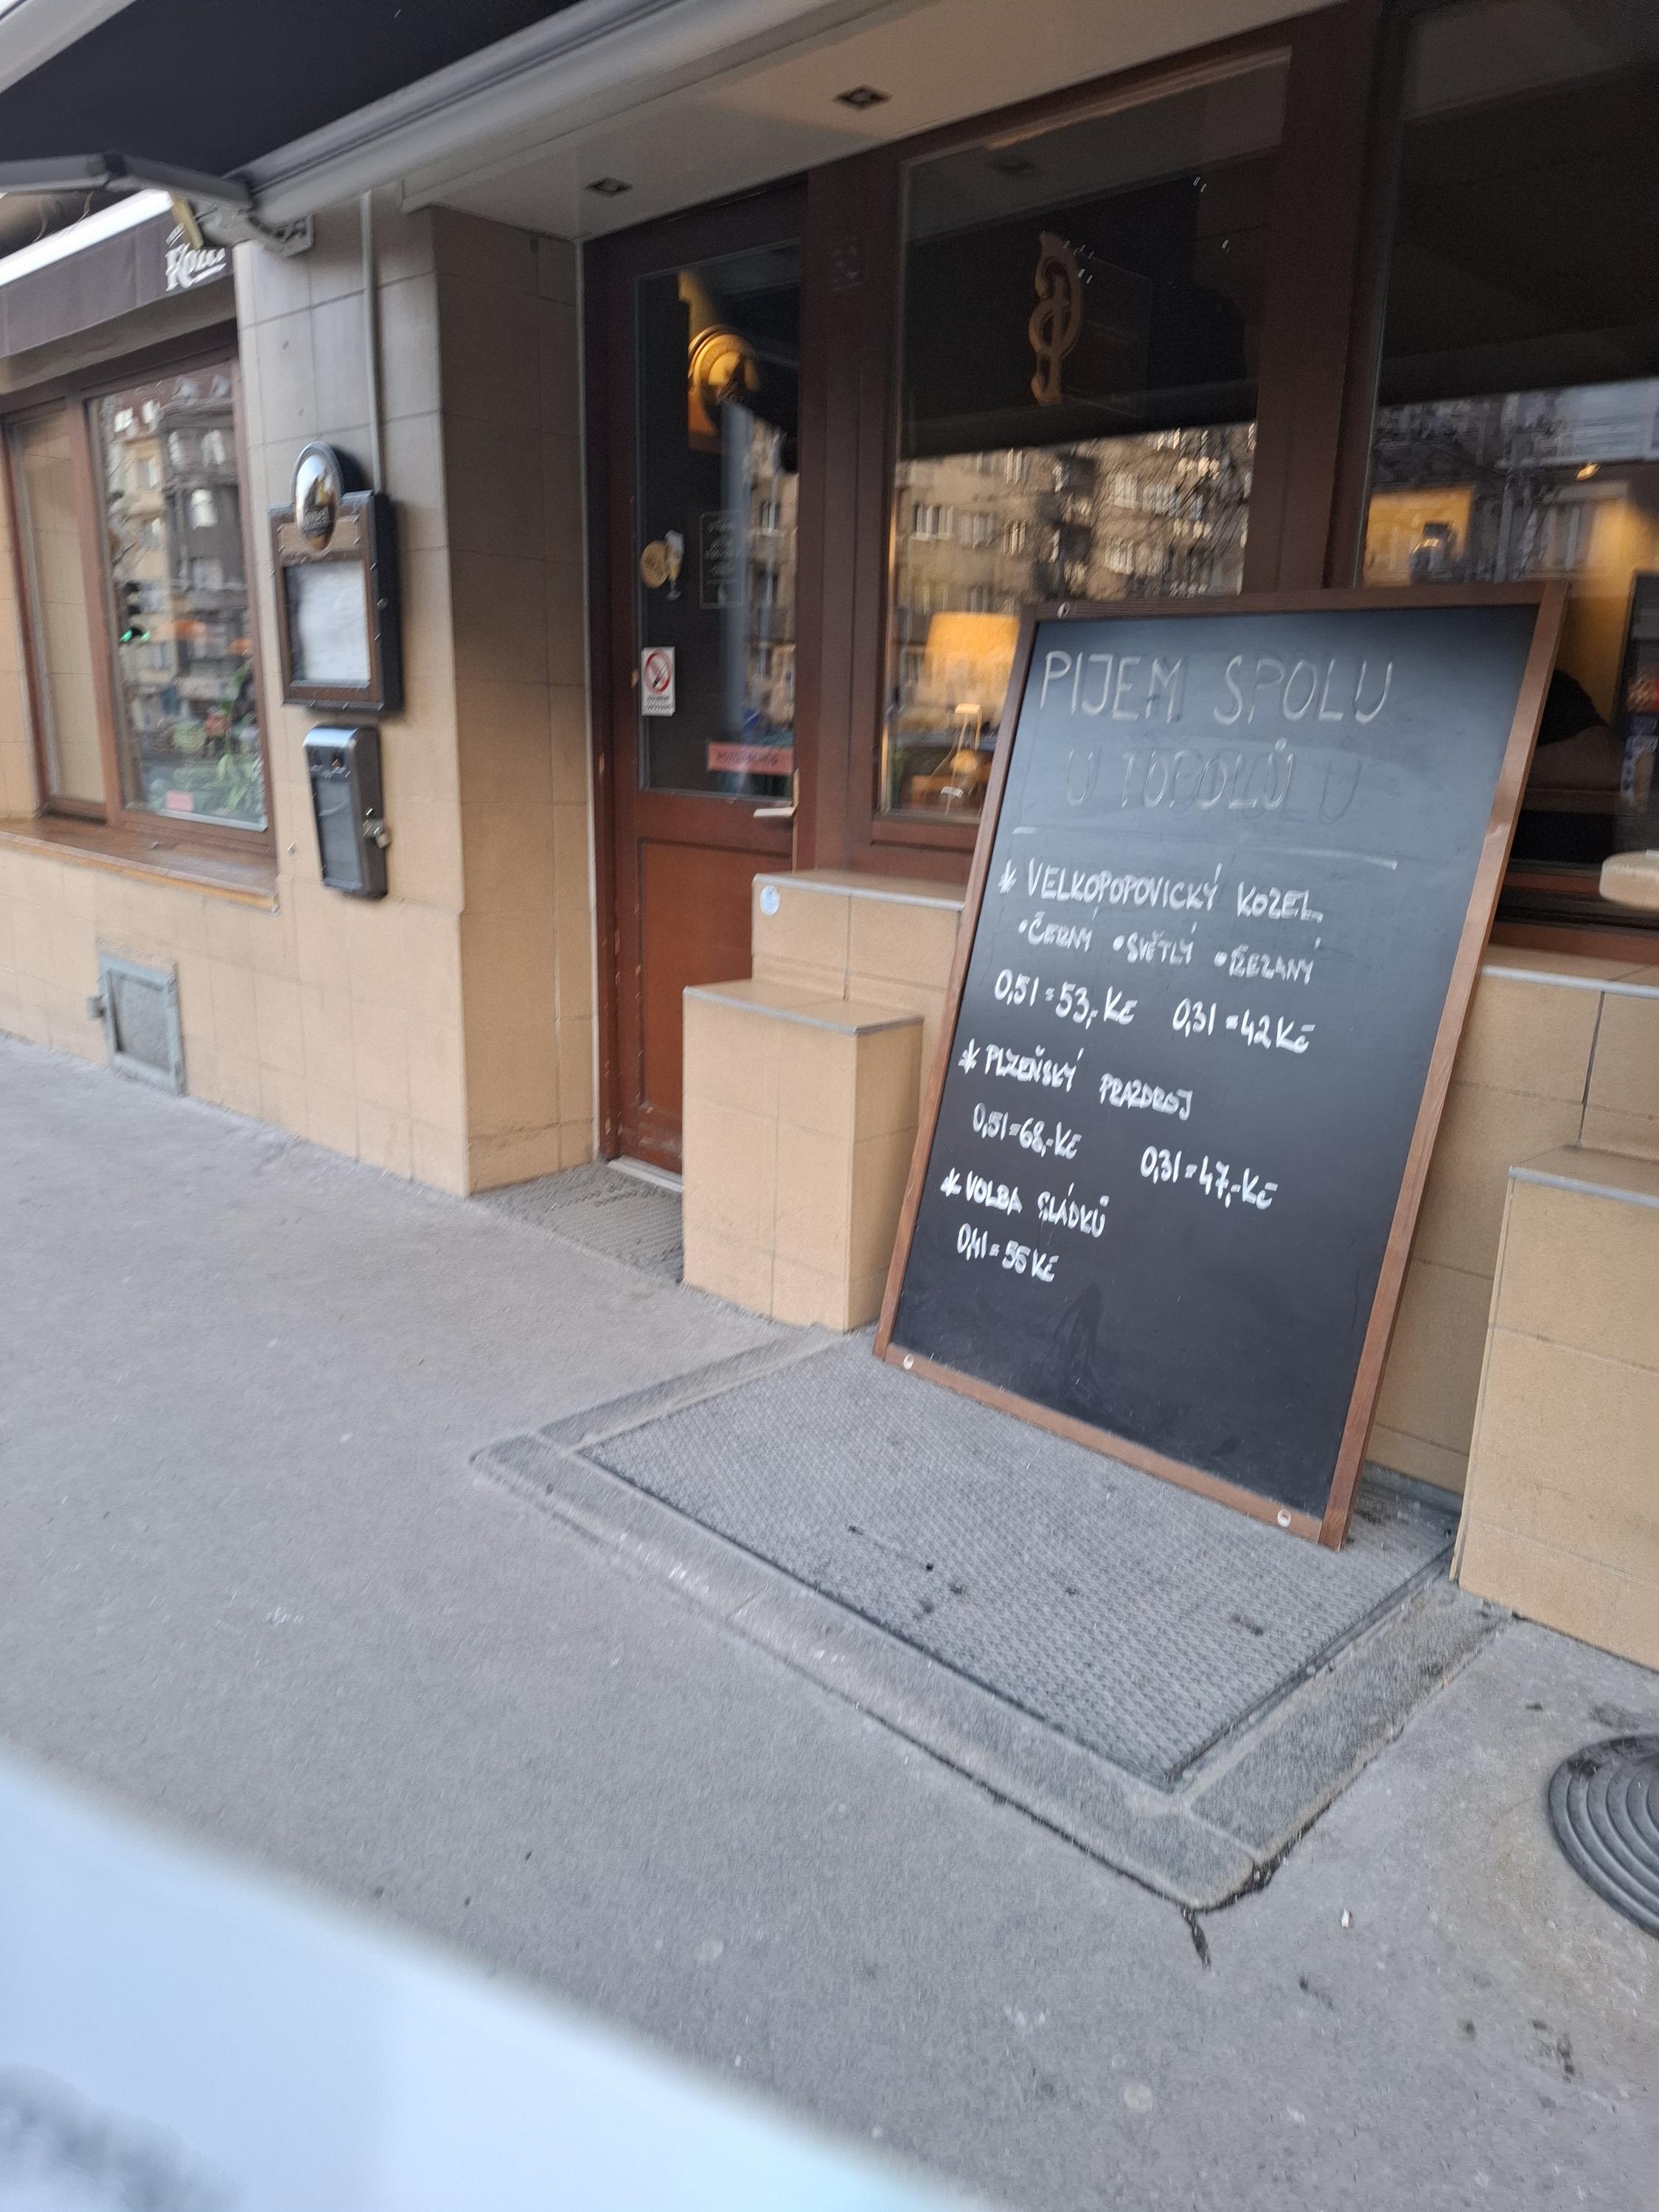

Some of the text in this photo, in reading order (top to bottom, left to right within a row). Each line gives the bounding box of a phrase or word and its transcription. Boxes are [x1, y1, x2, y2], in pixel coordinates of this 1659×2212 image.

[1039, 650, 1394, 726] PIJEM SPOLU
[1066, 748, 1096, 807] U
[1028, 857, 1324, 923] VELKOPOPOVICKÝ KOZEL
[1127, 922, 1197, 965] SVĚTLÝ
[985, 1044, 1193, 1121] PLZEŇSKÝ PRAZDROJ
[966, 1170, 1110, 1238] VOLBA SLÁDKŮ
